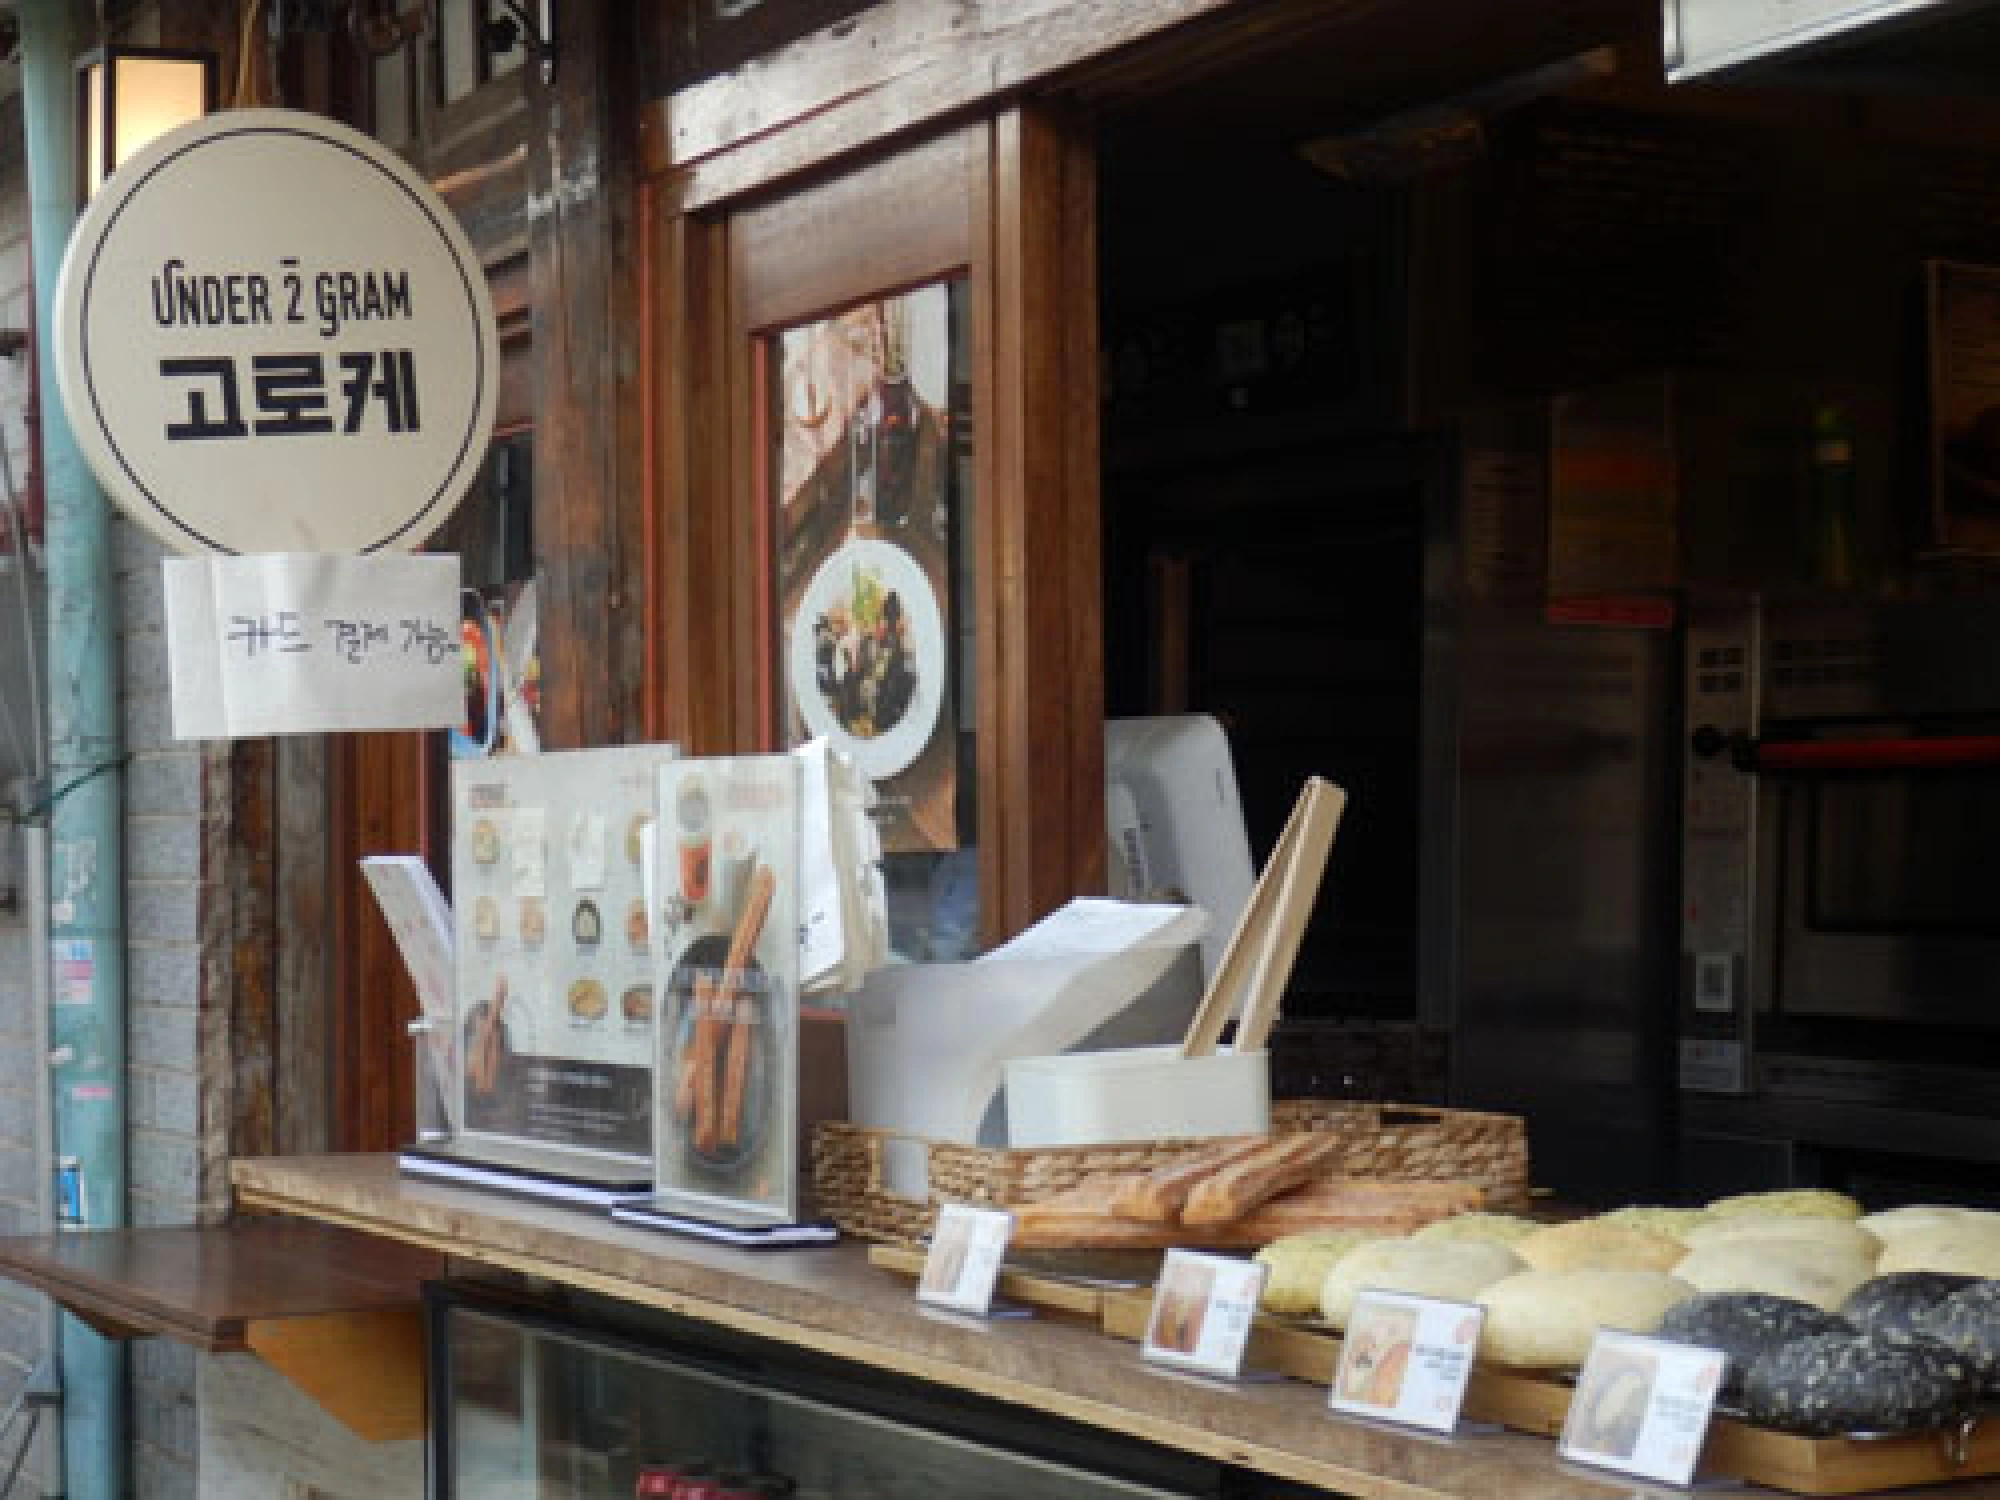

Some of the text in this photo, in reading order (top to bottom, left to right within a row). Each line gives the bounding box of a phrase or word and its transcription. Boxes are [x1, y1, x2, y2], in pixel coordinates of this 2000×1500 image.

[152, 258, 272, 326] UNDER
[316, 269, 412, 338] GRAM
[158, 350, 420, 441] 고로케
[226, 610, 313, 657] 카드
